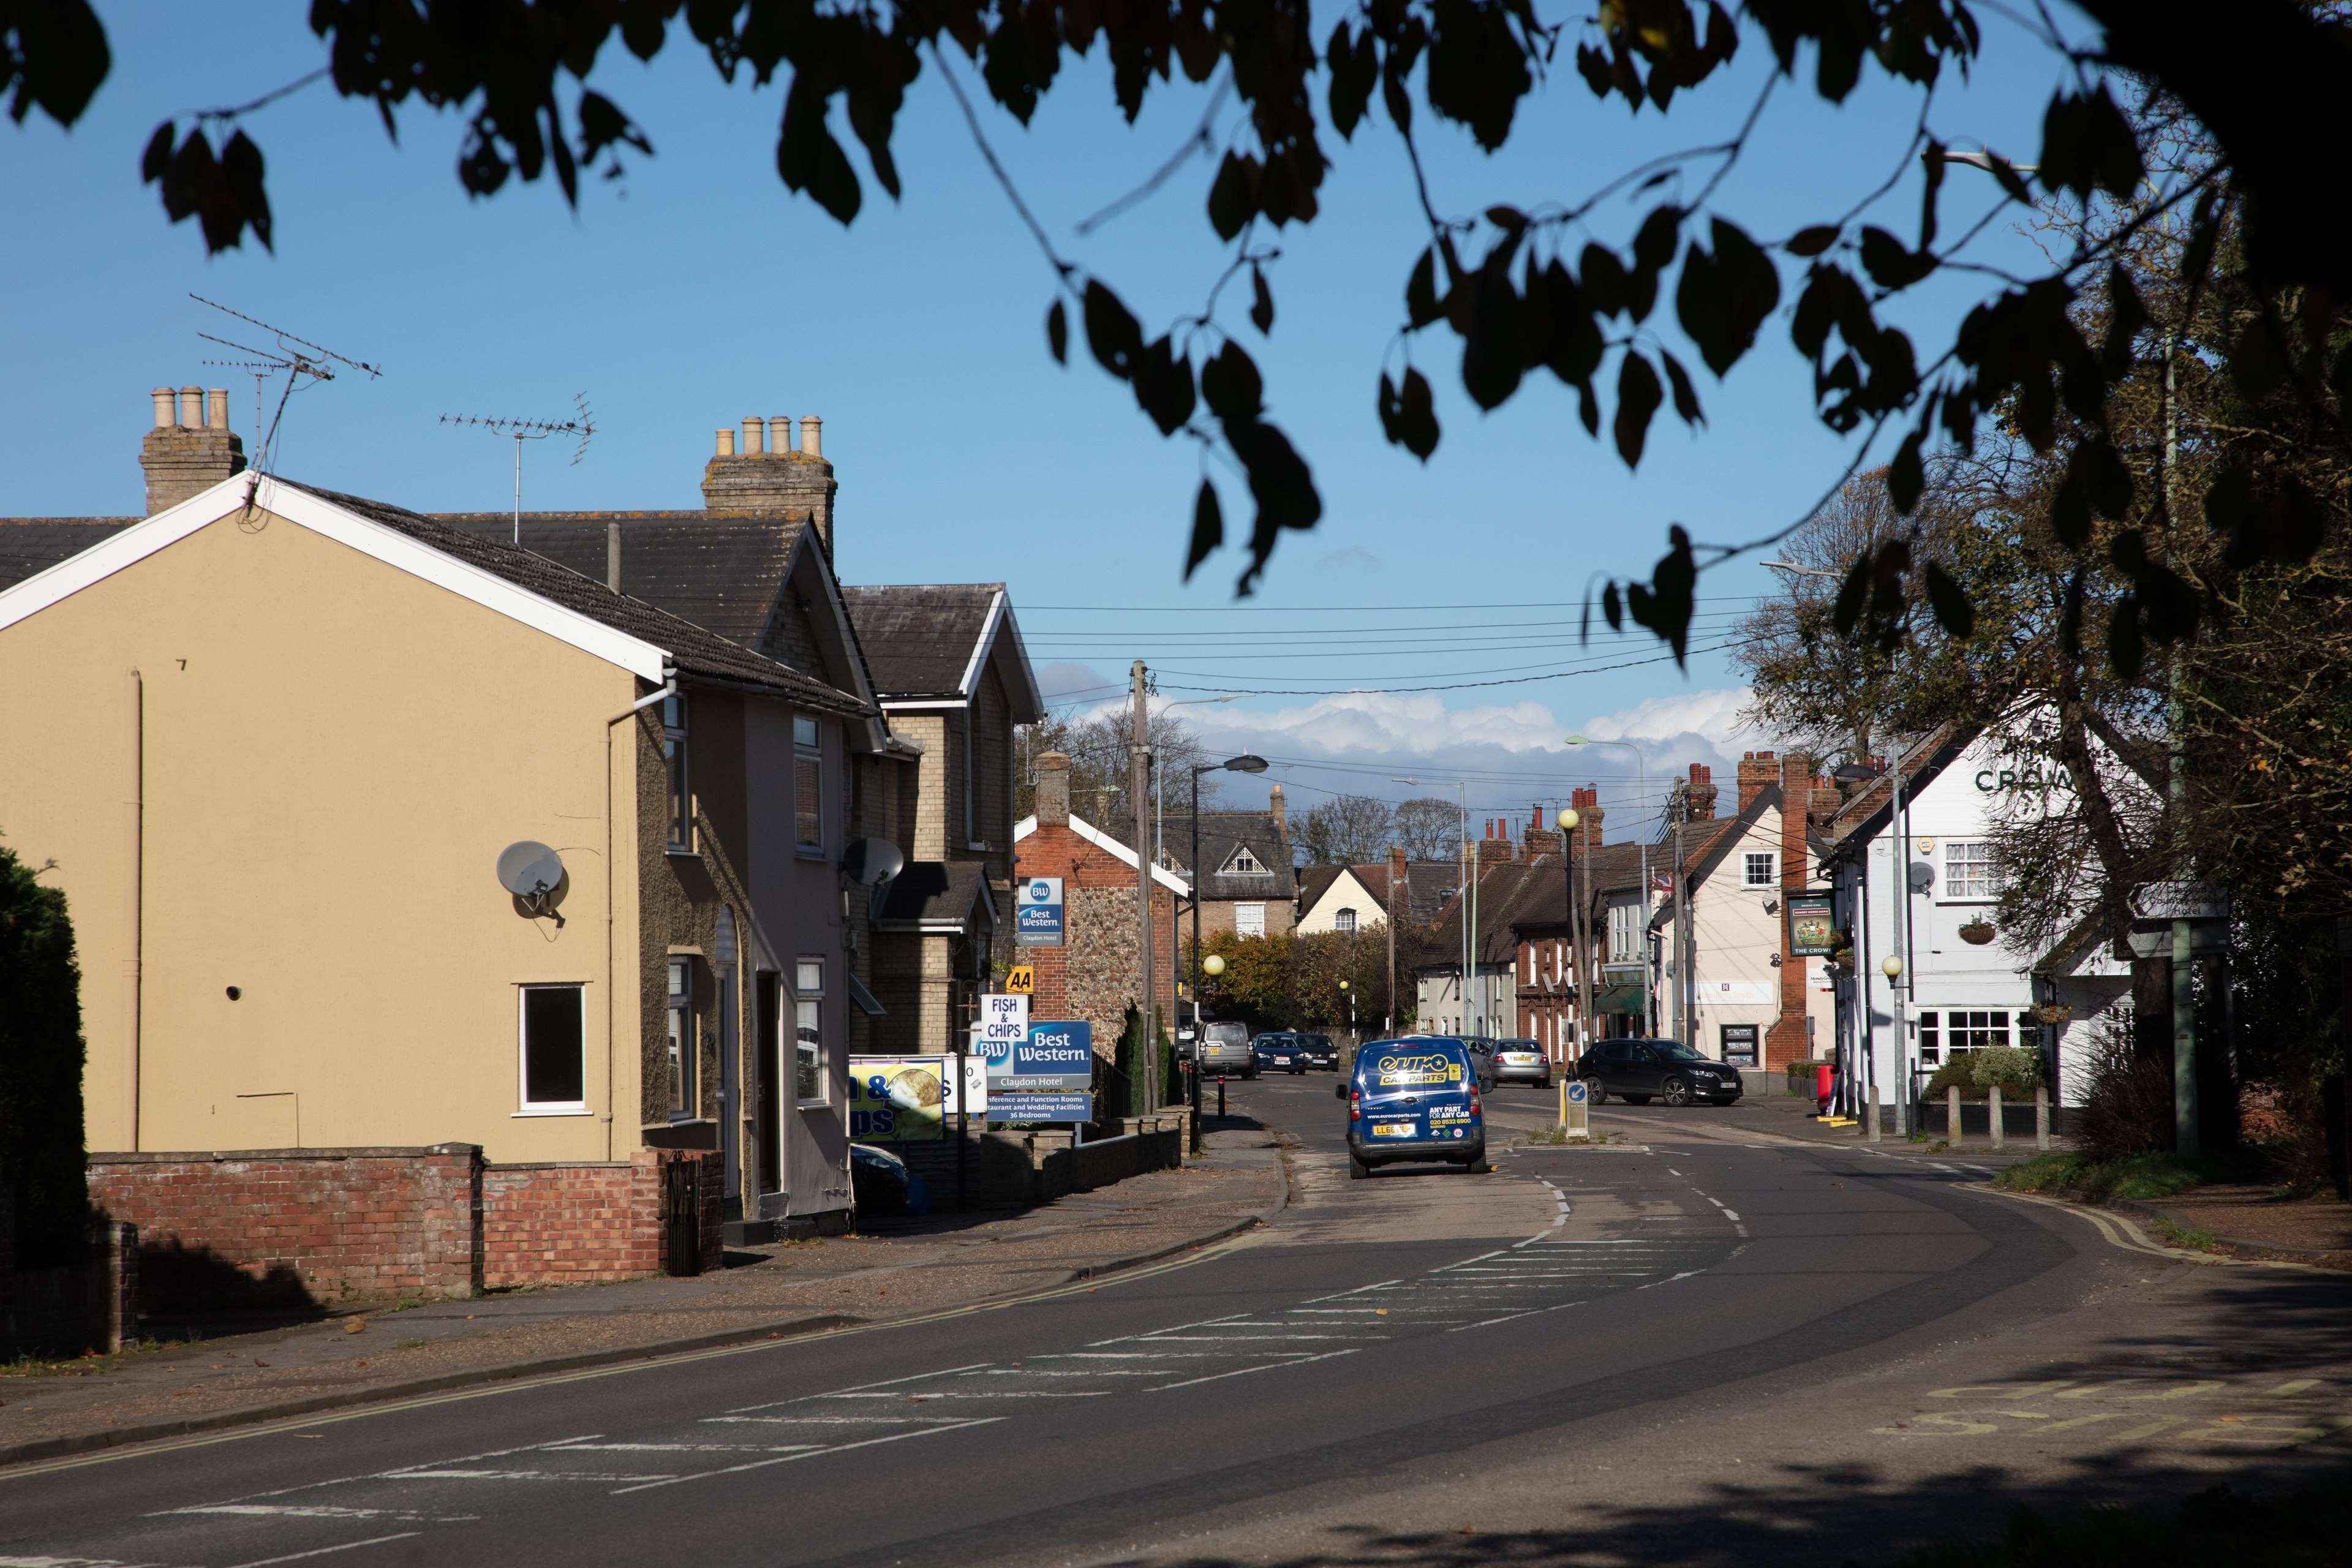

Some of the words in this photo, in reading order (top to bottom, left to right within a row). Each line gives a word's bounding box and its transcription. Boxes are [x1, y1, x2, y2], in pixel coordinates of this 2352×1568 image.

[1975, 770, 2100, 792] CROW
[1032, 888, 1049, 897] BW
[1030, 910, 1050, 918] Best
[1010, 972, 1030, 988] AA
[992, 998, 1017, 1012] FISH
[1001, 1013, 1008, 1023] &
[987, 1024, 1021, 1038] CHIPS
[1035, 1033, 1071, 1047] Best
[979, 1042, 1007, 1057] BW
[1019, 1047, 1085, 1061] Western
[1378, 1054, 1449, 1074] euro
[867, 1074, 892, 1101] &
[1000, 1077, 1036, 1088] Claydon
[1039, 1077, 1063, 1085] Hotel
